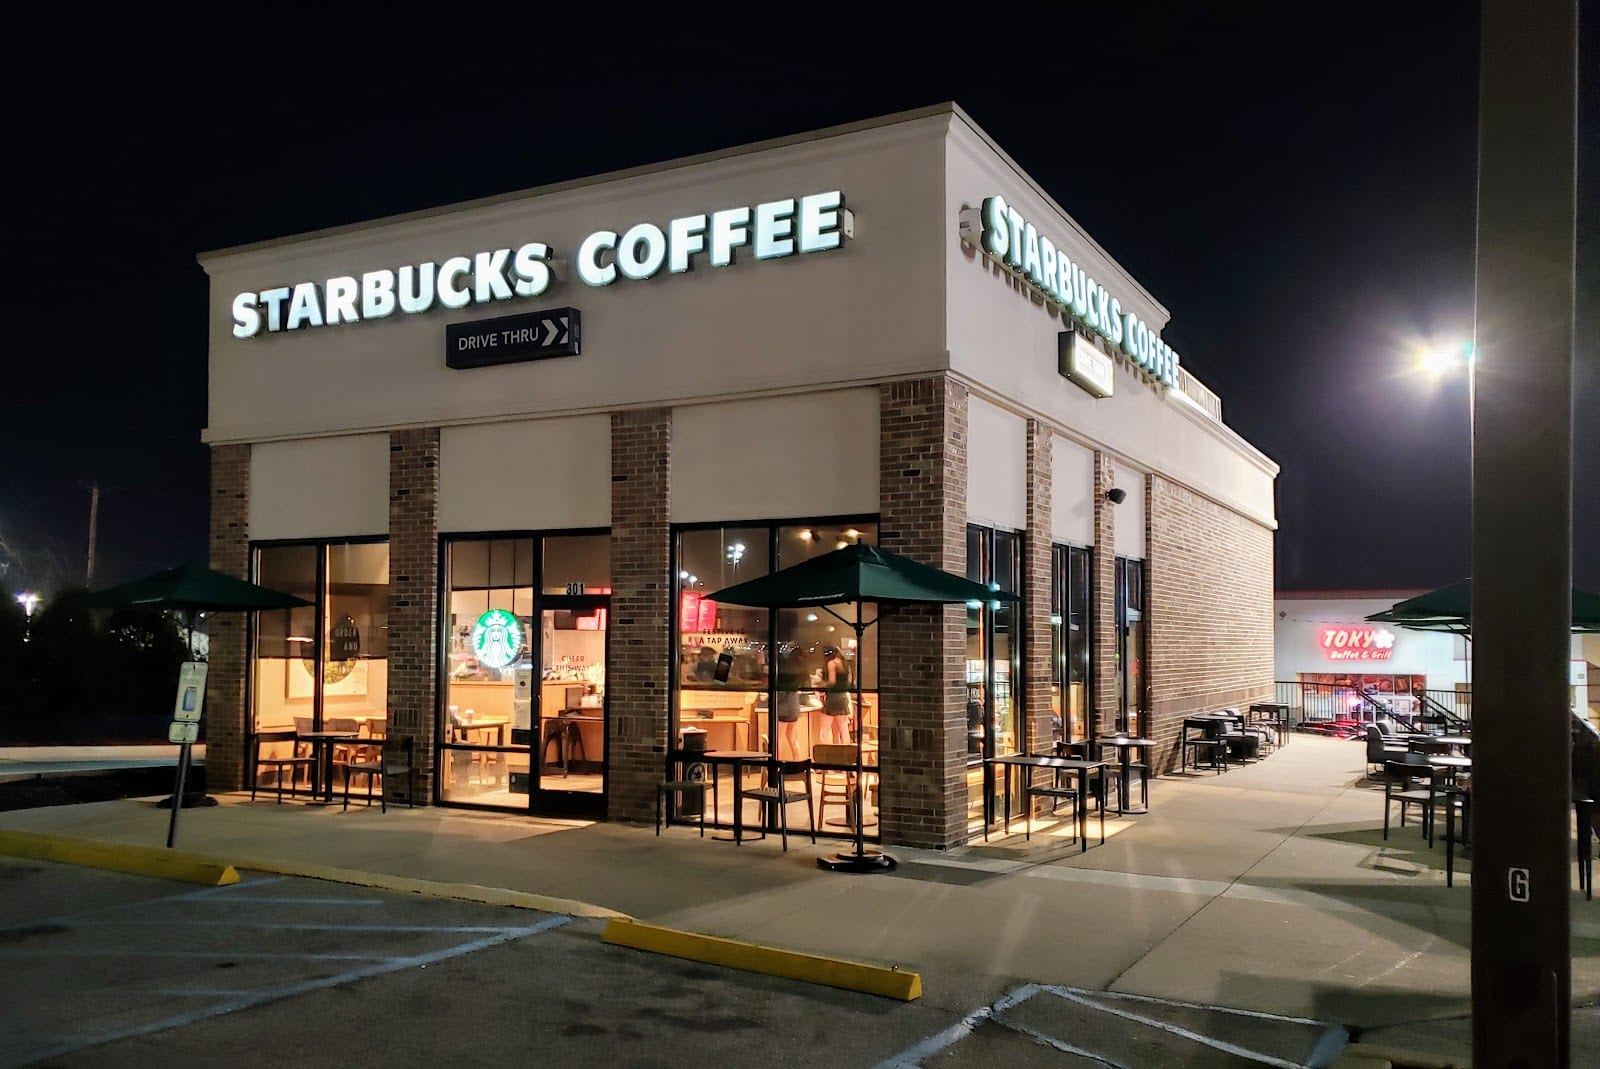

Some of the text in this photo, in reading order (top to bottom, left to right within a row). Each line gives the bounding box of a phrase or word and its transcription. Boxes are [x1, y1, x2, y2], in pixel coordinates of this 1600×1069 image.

[231, 190, 843, 339] STARBUCKS COFFEE
[982, 195, 1180, 390] STARBUCKS COFFEE
[458, 327, 539, 351] DRIVE THRU
[566, 583, 584, 595] 301
[707, 637, 722, 645] TAP
[724, 637, 749, 645] AWAY
[1330, 650, 1359, 659] Buffet
[1371, 650, 1392, 659] Grill
[1509, 868, 1529, 901] G
